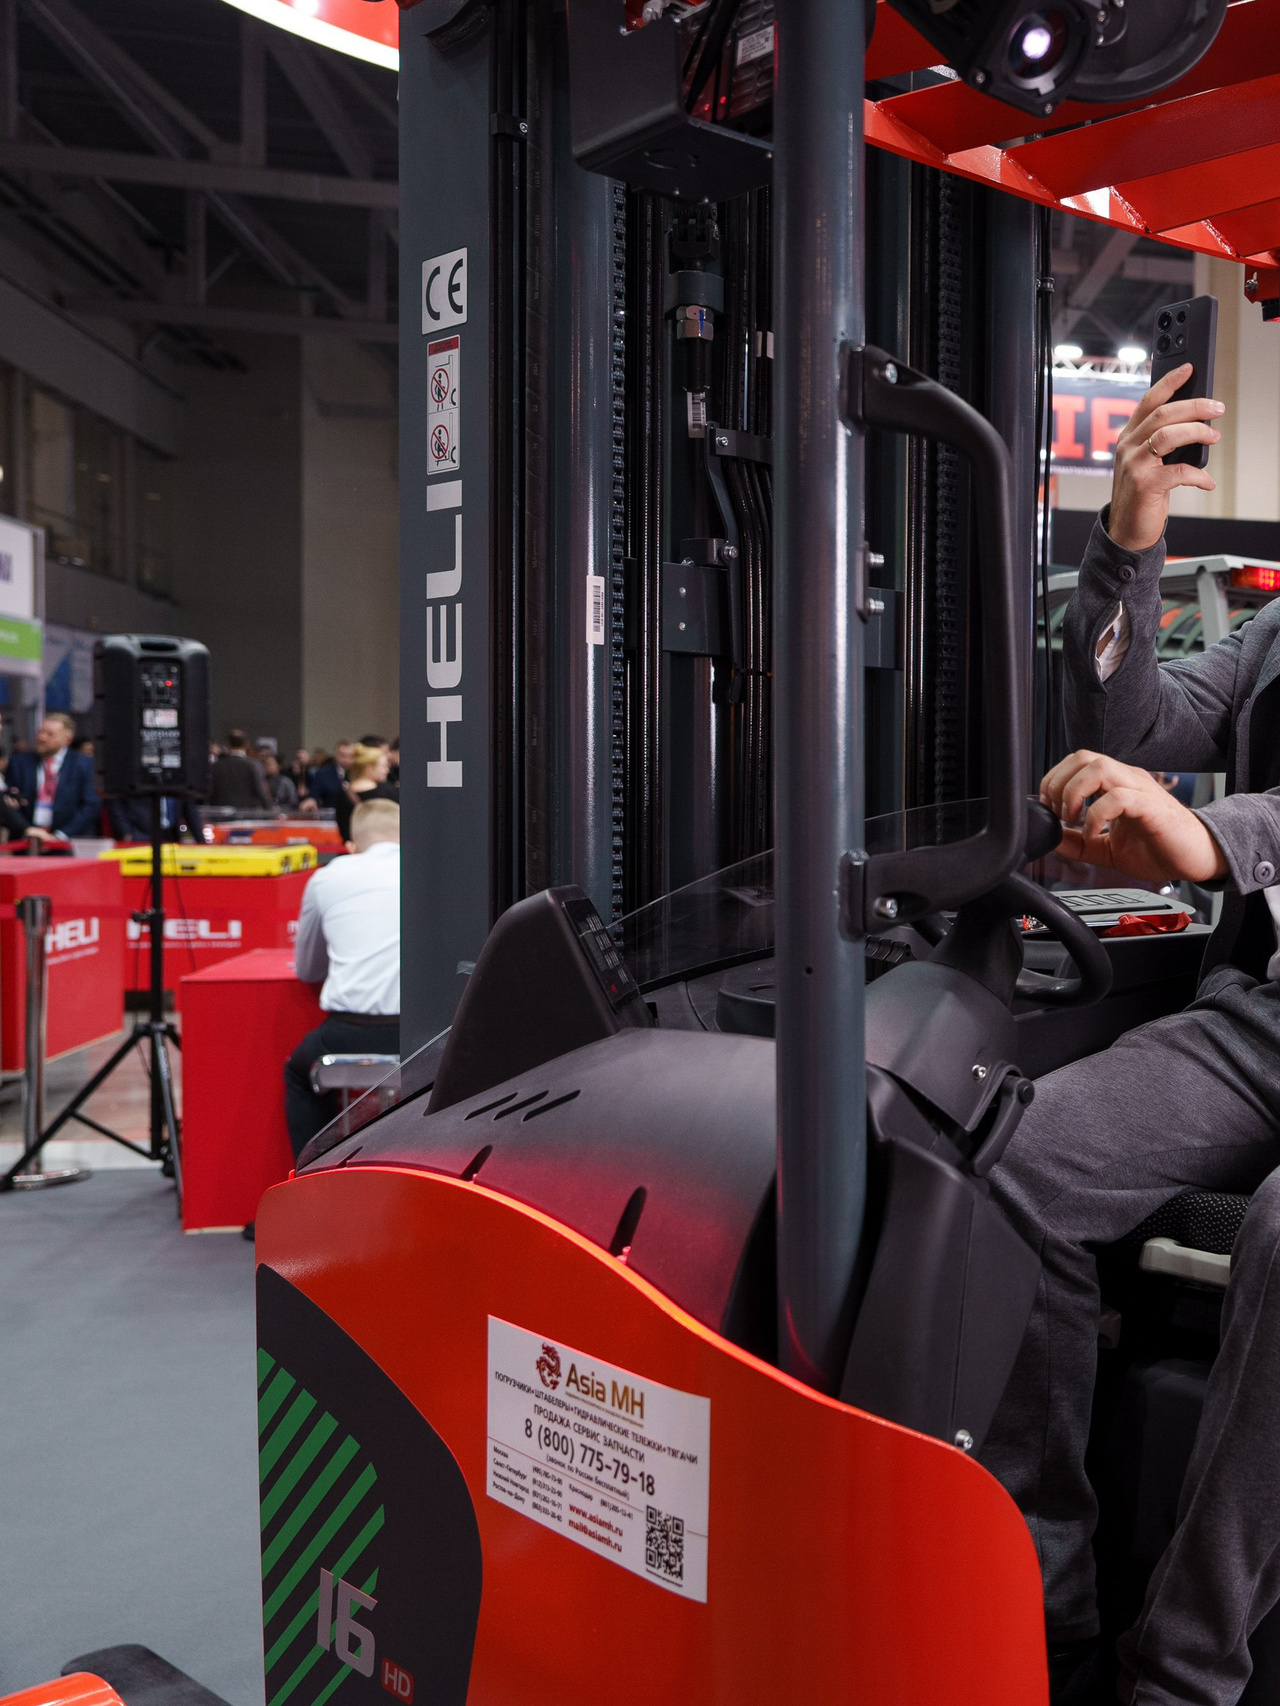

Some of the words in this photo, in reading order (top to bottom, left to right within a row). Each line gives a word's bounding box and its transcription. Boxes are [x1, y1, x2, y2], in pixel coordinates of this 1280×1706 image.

[426, 479, 463, 788] HELI
[45, 917, 98, 954] HELI
[126, 918, 242, 940] HELI
[566, 1363, 606, 1403] Asia
[611, 1379, 644, 1419] MH
[534, 1404, 571, 1429] ПРОДАЖА
[573, 1422, 601, 1443] СЕРВИС
[603, 1435, 645, 1463] ЗАПЧАСТИ
[631, 1431, 662, 1452] ТЕЛЕЖКИ
[667, 1446, 698, 1464] ТЯГАЧИ
[525, 1418, 533, 1438] 8
[538, 1424, 575, 1464] (800)
[580, 1443, 655, 1495] 775-79-18
[568, 1503, 624, 1537] www.asiamh.ru
[568, 1519, 623, 1552] mail@asiamh.ru
[316, 1567, 378, 1678] 16
[384, 1662, 411, 1698] HD
